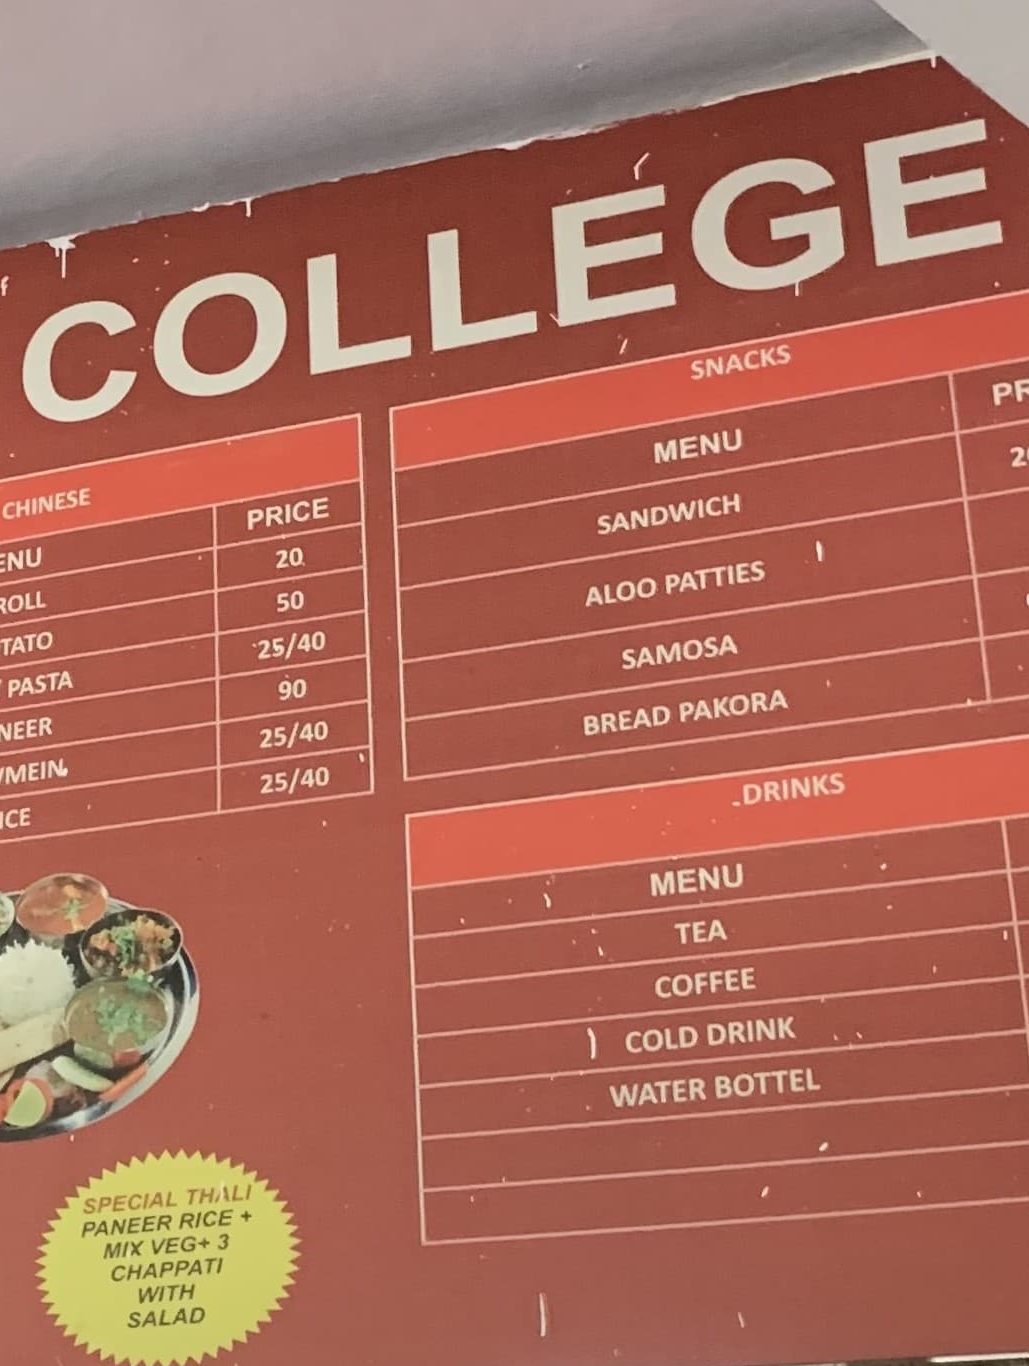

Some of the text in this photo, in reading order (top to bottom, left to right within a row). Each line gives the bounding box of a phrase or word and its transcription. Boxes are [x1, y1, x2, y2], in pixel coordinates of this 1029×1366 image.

[19, 118, 1008, 424] COLLEGE
[691, 345, 791, 379] SNACKS
[654, 429, 741, 463] MENU
[1011, 447, 1029, 467] 2
[3, 488, 90, 519] CHINESE
[248, 497, 329, 530] PRICE
[598, 494, 740, 534] SANDWICH
[276, 548, 304, 568] 20
[586, 561, 765, 606] ALOO PATTIES
[278, 591, 304, 612] 50
[258, 632, 325, 659] 25/40
[623, 635, 737, 669] SAMOSA
[8, 671, 73, 697] PASTA
[279, 679, 306, 700] 90
[584, 690, 788, 735] BREAD PAKORA
[260, 721, 328, 748] 25/40
[261, 767, 329, 794] 25/40
[743, 773, 845, 804] DRINKS
[651, 864, 743, 896] MENU
[675, 920, 727, 944] TEA
[655, 968, 755, 998] COFFEE
[626, 1017, 795, 1053] COLD DRINK
[610, 1068, 820, 1107] WATER BOTTEL
[83, 1184, 251, 1214] SPECIAL THALI
[82, 1215, 172, 1237] PANEER
[179, 1210, 233, 1229] RICE
[104, 1241, 143, 1259] MIX
[218, 1234, 229, 1250] 3
[111, 1258, 223, 1281] CHAPPATI
[139, 1284, 195, 1304] WITH
[128, 1307, 205, 1328] SALAD
